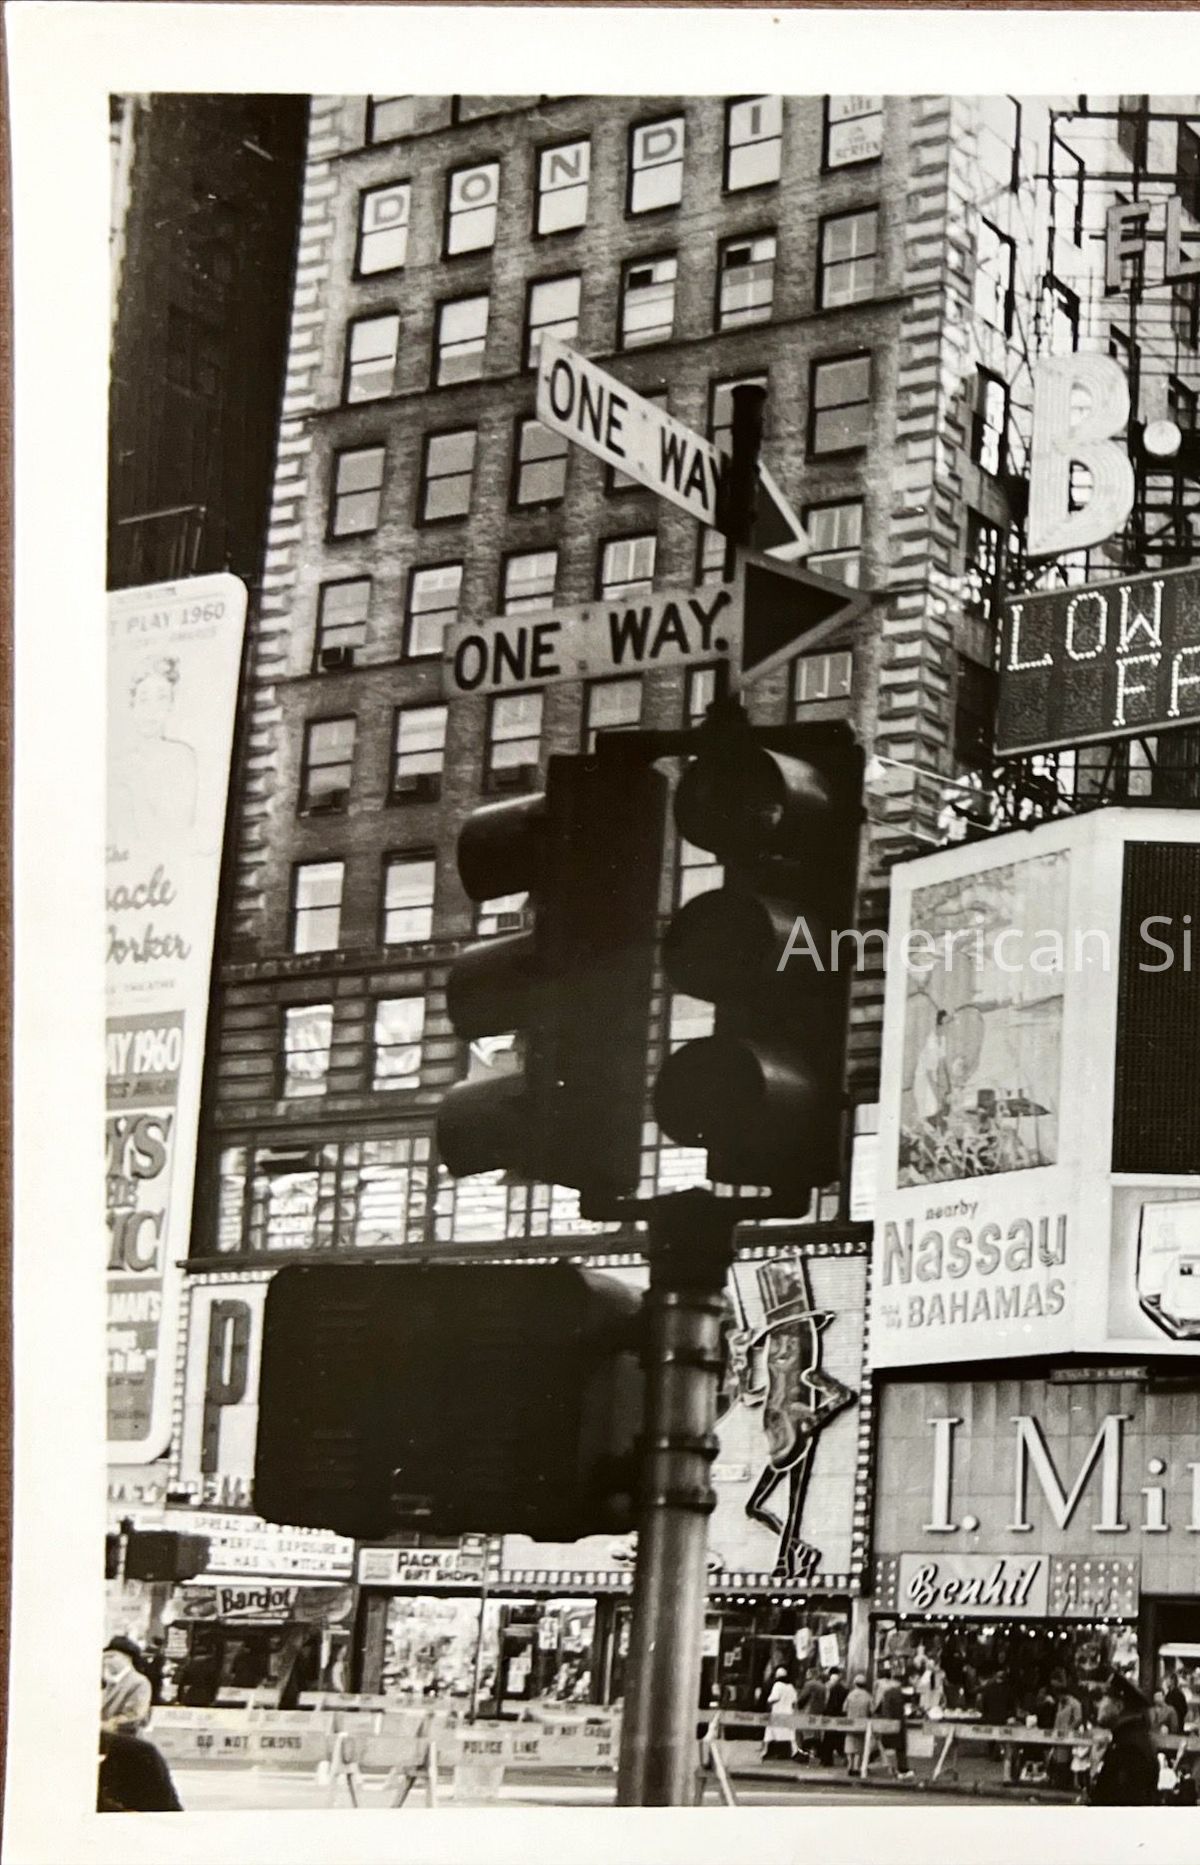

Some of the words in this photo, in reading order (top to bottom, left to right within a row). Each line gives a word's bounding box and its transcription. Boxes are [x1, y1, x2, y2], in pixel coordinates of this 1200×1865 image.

[549, 358, 628, 459] ONE
[181, 602, 225, 625] 1960
[1006, 580, 1165, 672] LOW
[454, 622, 562, 691] ONE
[133, 1027, 182, 1075] 1960
[925, 1199, 979, 1220] nearby
[881, 1213, 1068, 1287] Nassau
[907, 1278, 1066, 1329] BAHAMAS
[220, 1587, 292, 1615] Bardot
[908, 1559, 1042, 1610] Benhil
[223, 1734, 250, 1749] NOT
[259, 1735, 303, 1749] CROSS
[462, 1739, 504, 1754] POLICE
[512, 1739, 540, 1754] LINE
